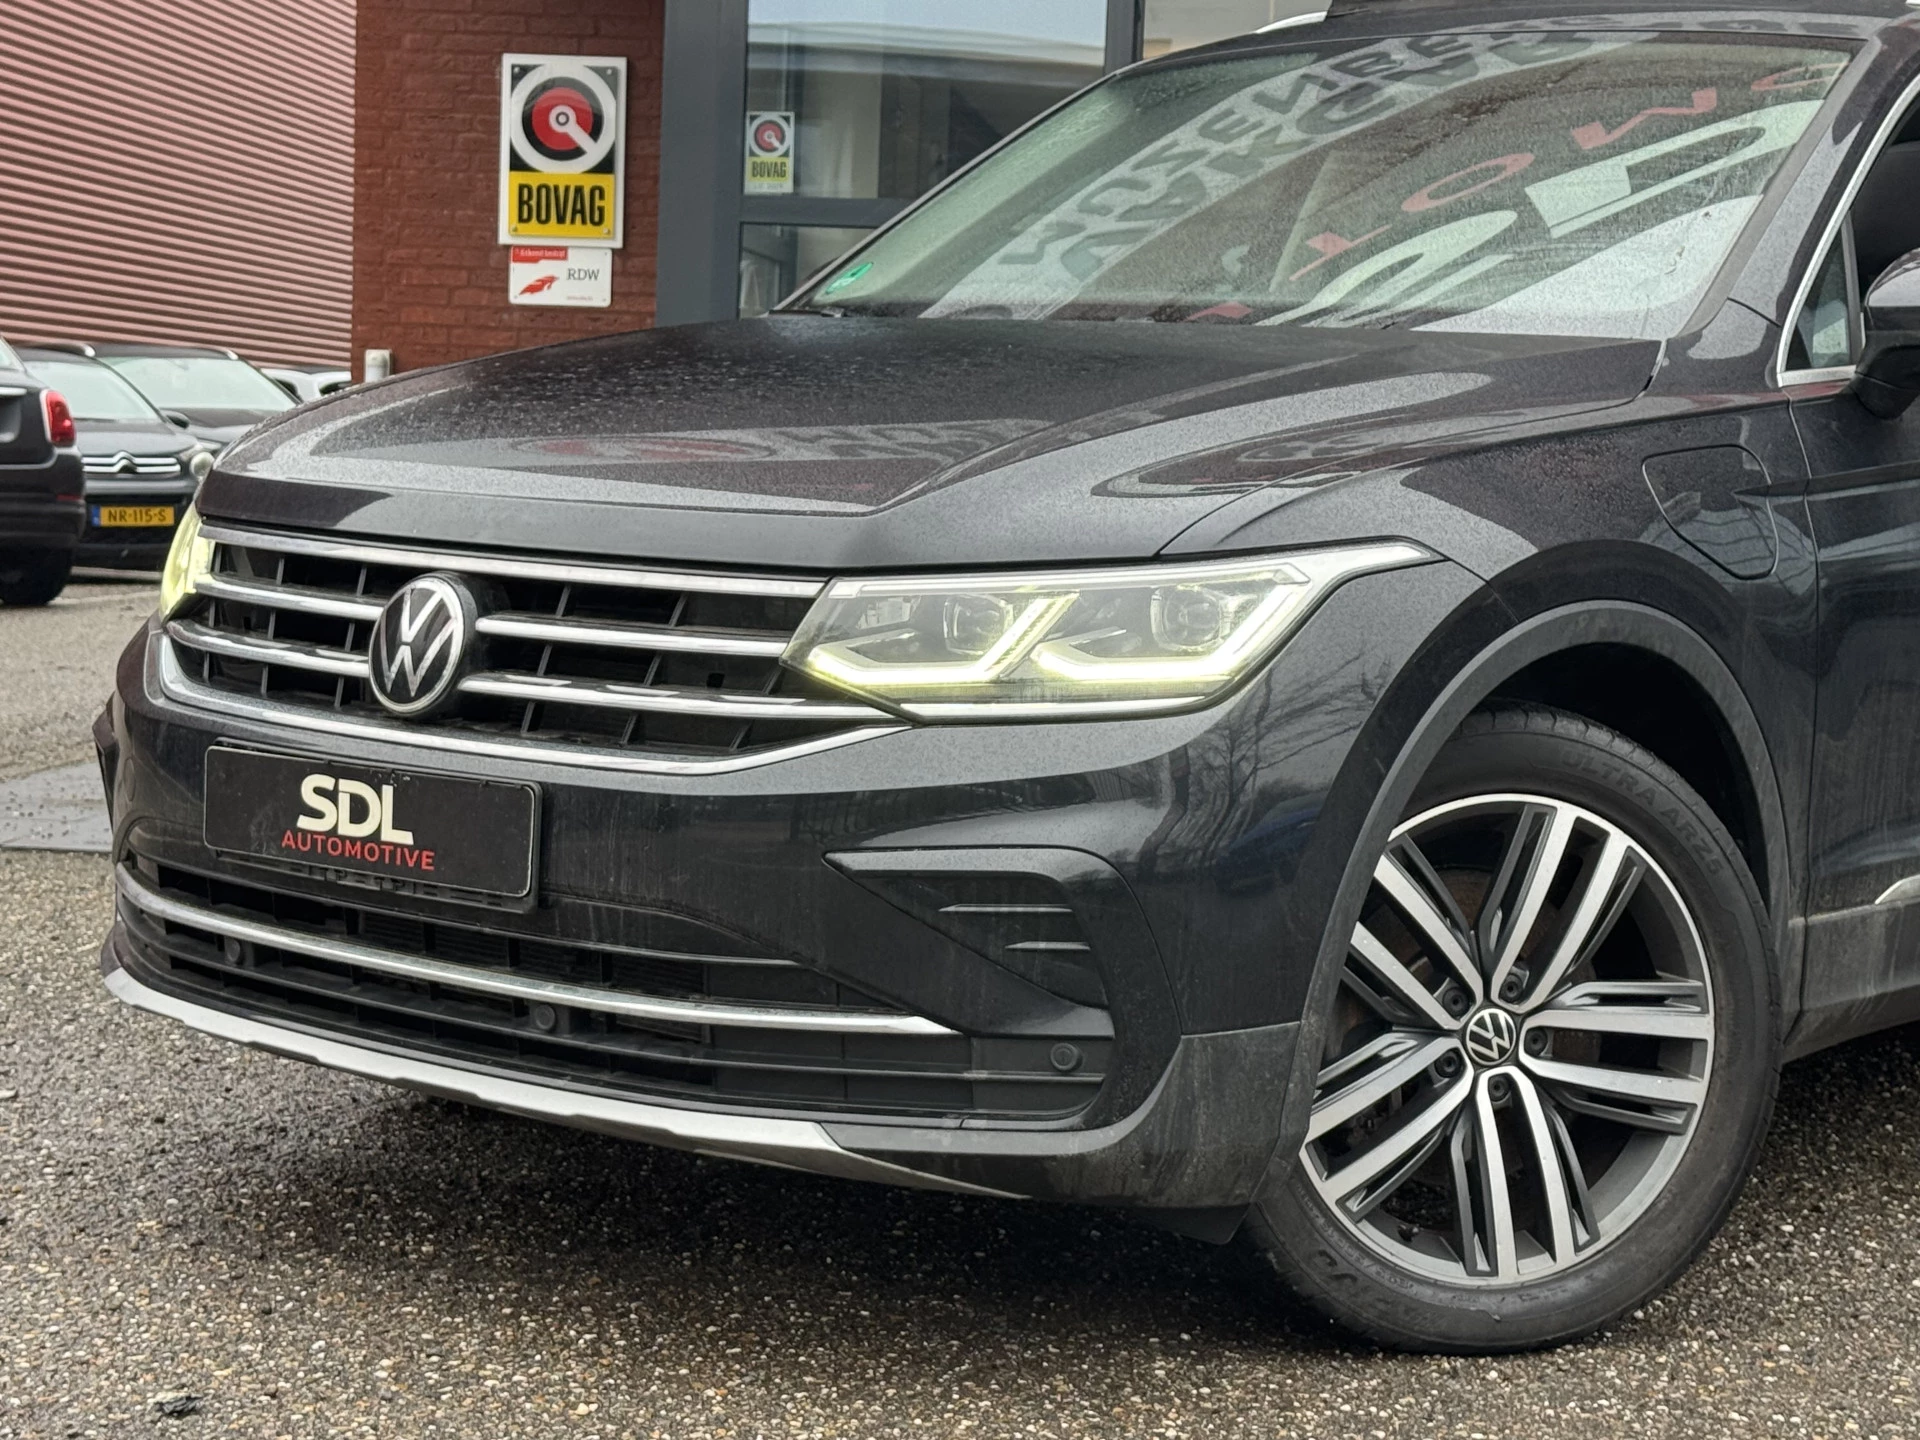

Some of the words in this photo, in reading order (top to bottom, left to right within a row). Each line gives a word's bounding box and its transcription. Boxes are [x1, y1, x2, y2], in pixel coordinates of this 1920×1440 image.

[752, 161, 787, 178] BOVAG
[518, 183, 605, 226] BOVAG
[567, 268, 600, 281] RDW
[108, 508, 167, 523] NR-115-S
[1561, 752, 1657, 806] ULTRA
[296, 773, 414, 845] SDL
[281, 829, 435, 871] AUTOMOTIVE
